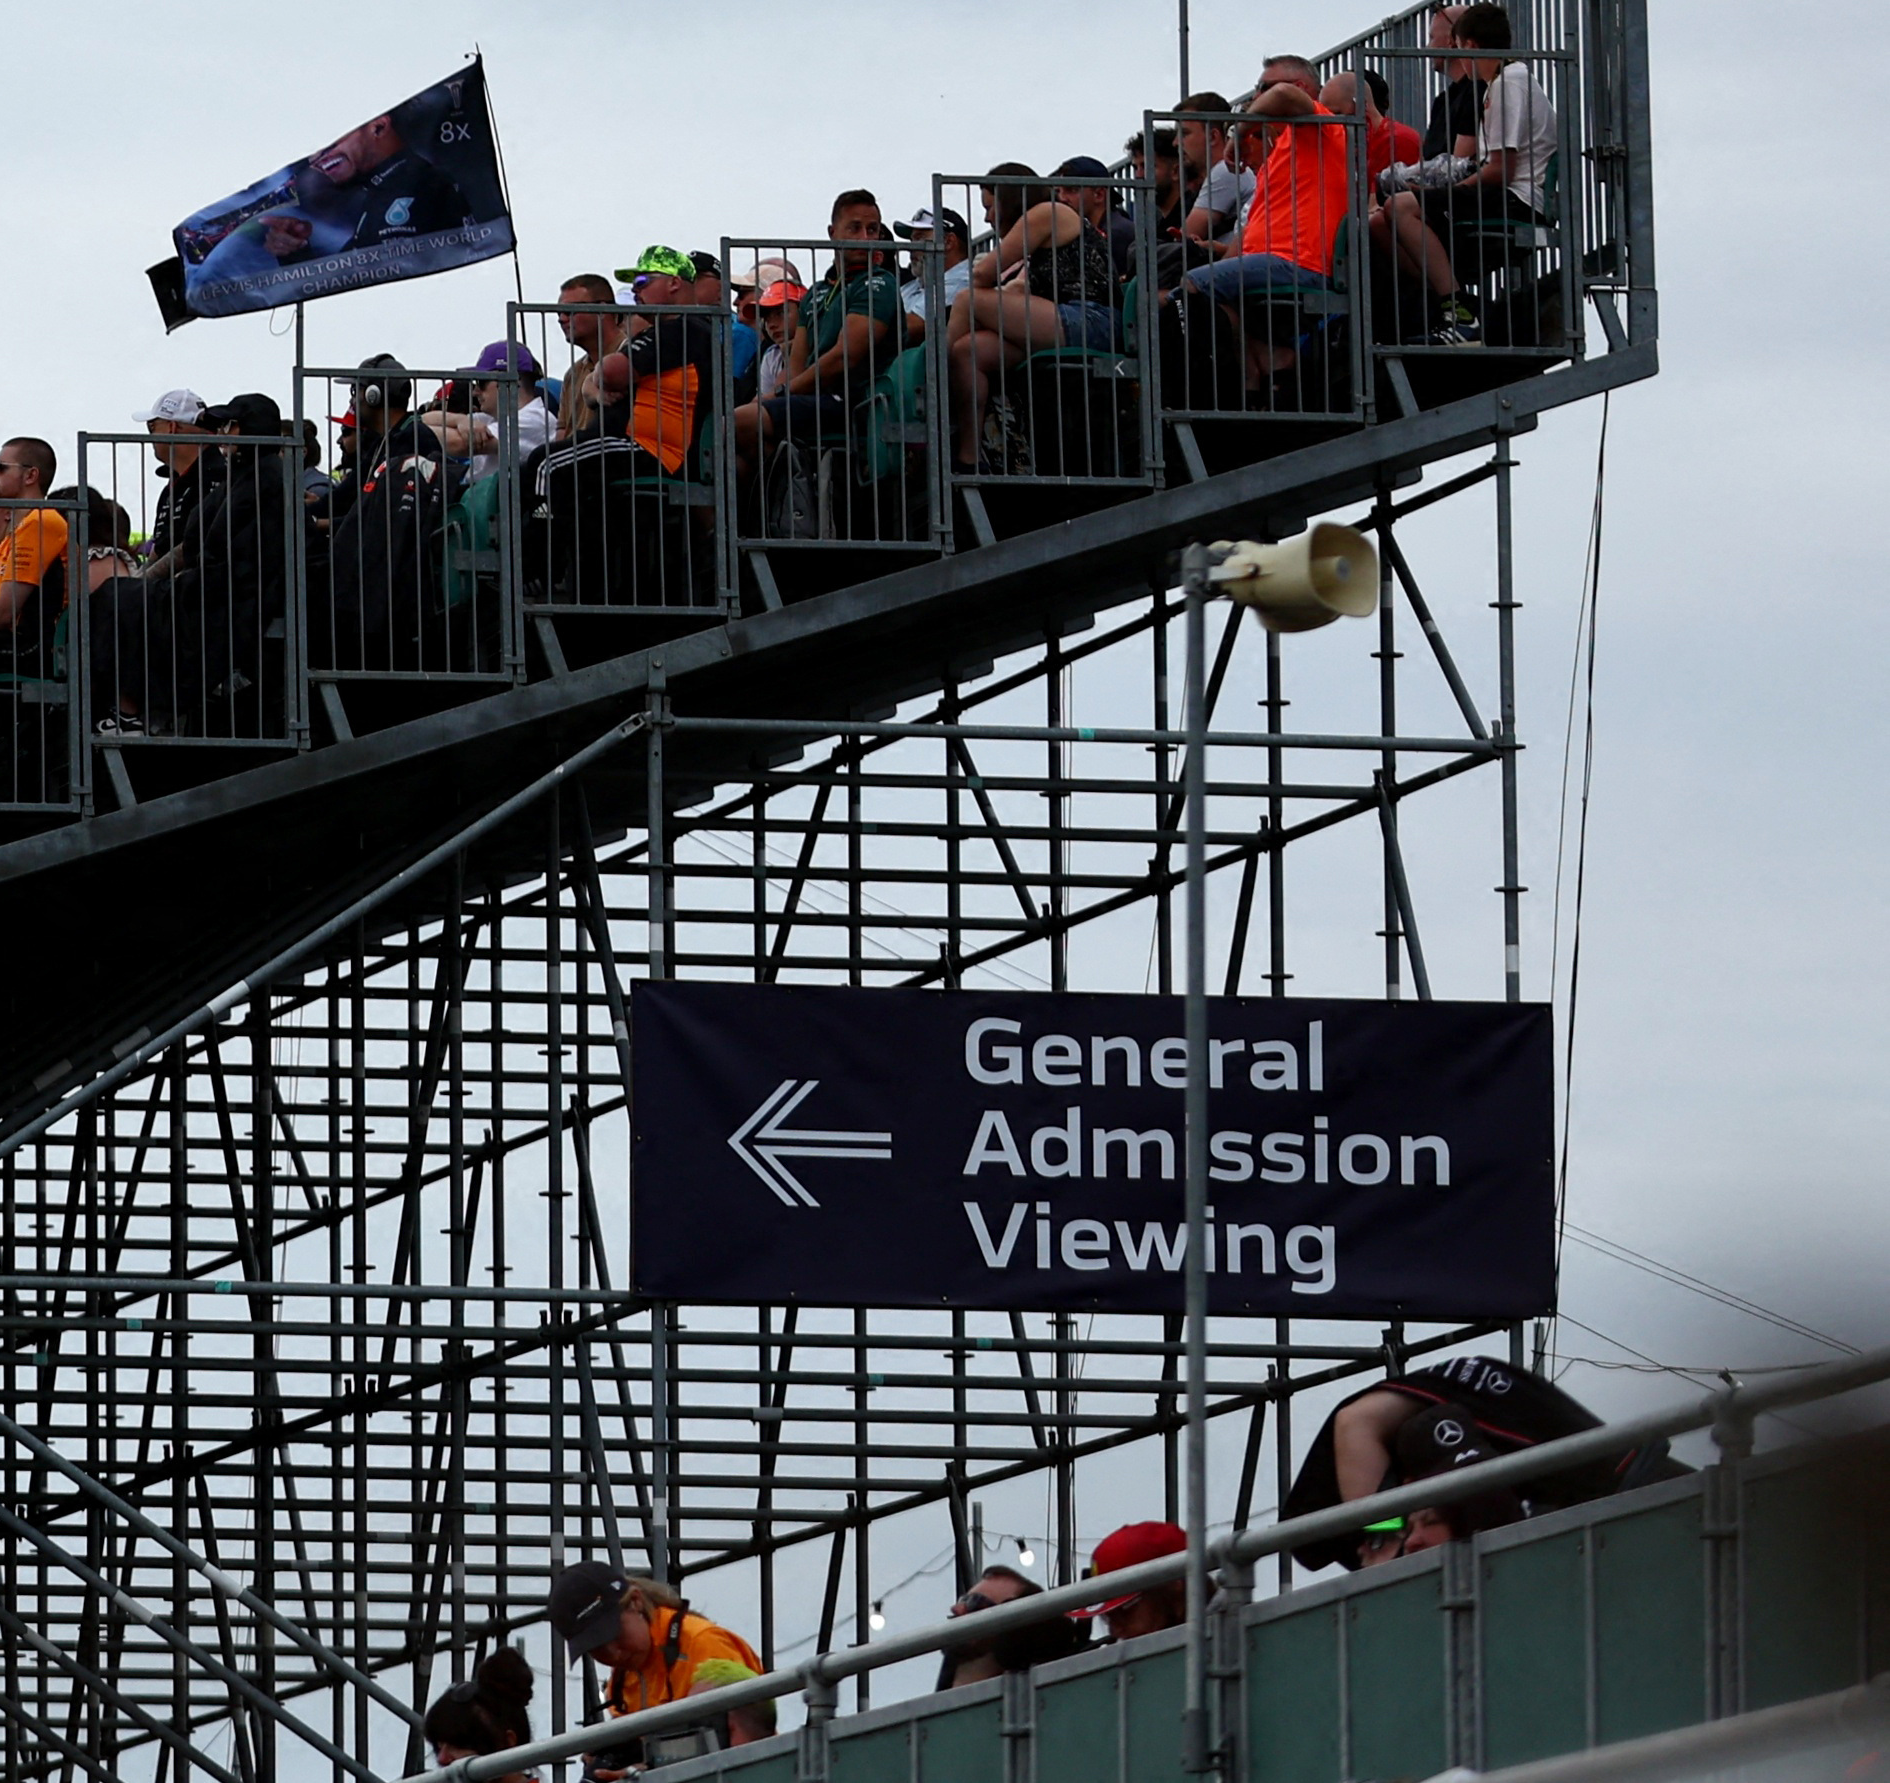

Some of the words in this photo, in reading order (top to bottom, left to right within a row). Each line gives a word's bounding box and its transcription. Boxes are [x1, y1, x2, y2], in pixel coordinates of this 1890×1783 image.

[257, 255, 353, 288] HAMILTON
[387, 241, 425, 259] TIME
[428, 227, 492, 249] WORLD
[303, 266, 401, 295] CHAMPION
[965, 1017, 1323, 1091] General
[962, 1105, 1450, 1185] Admssion
[963, 1201, 1336, 1295] Viewing
